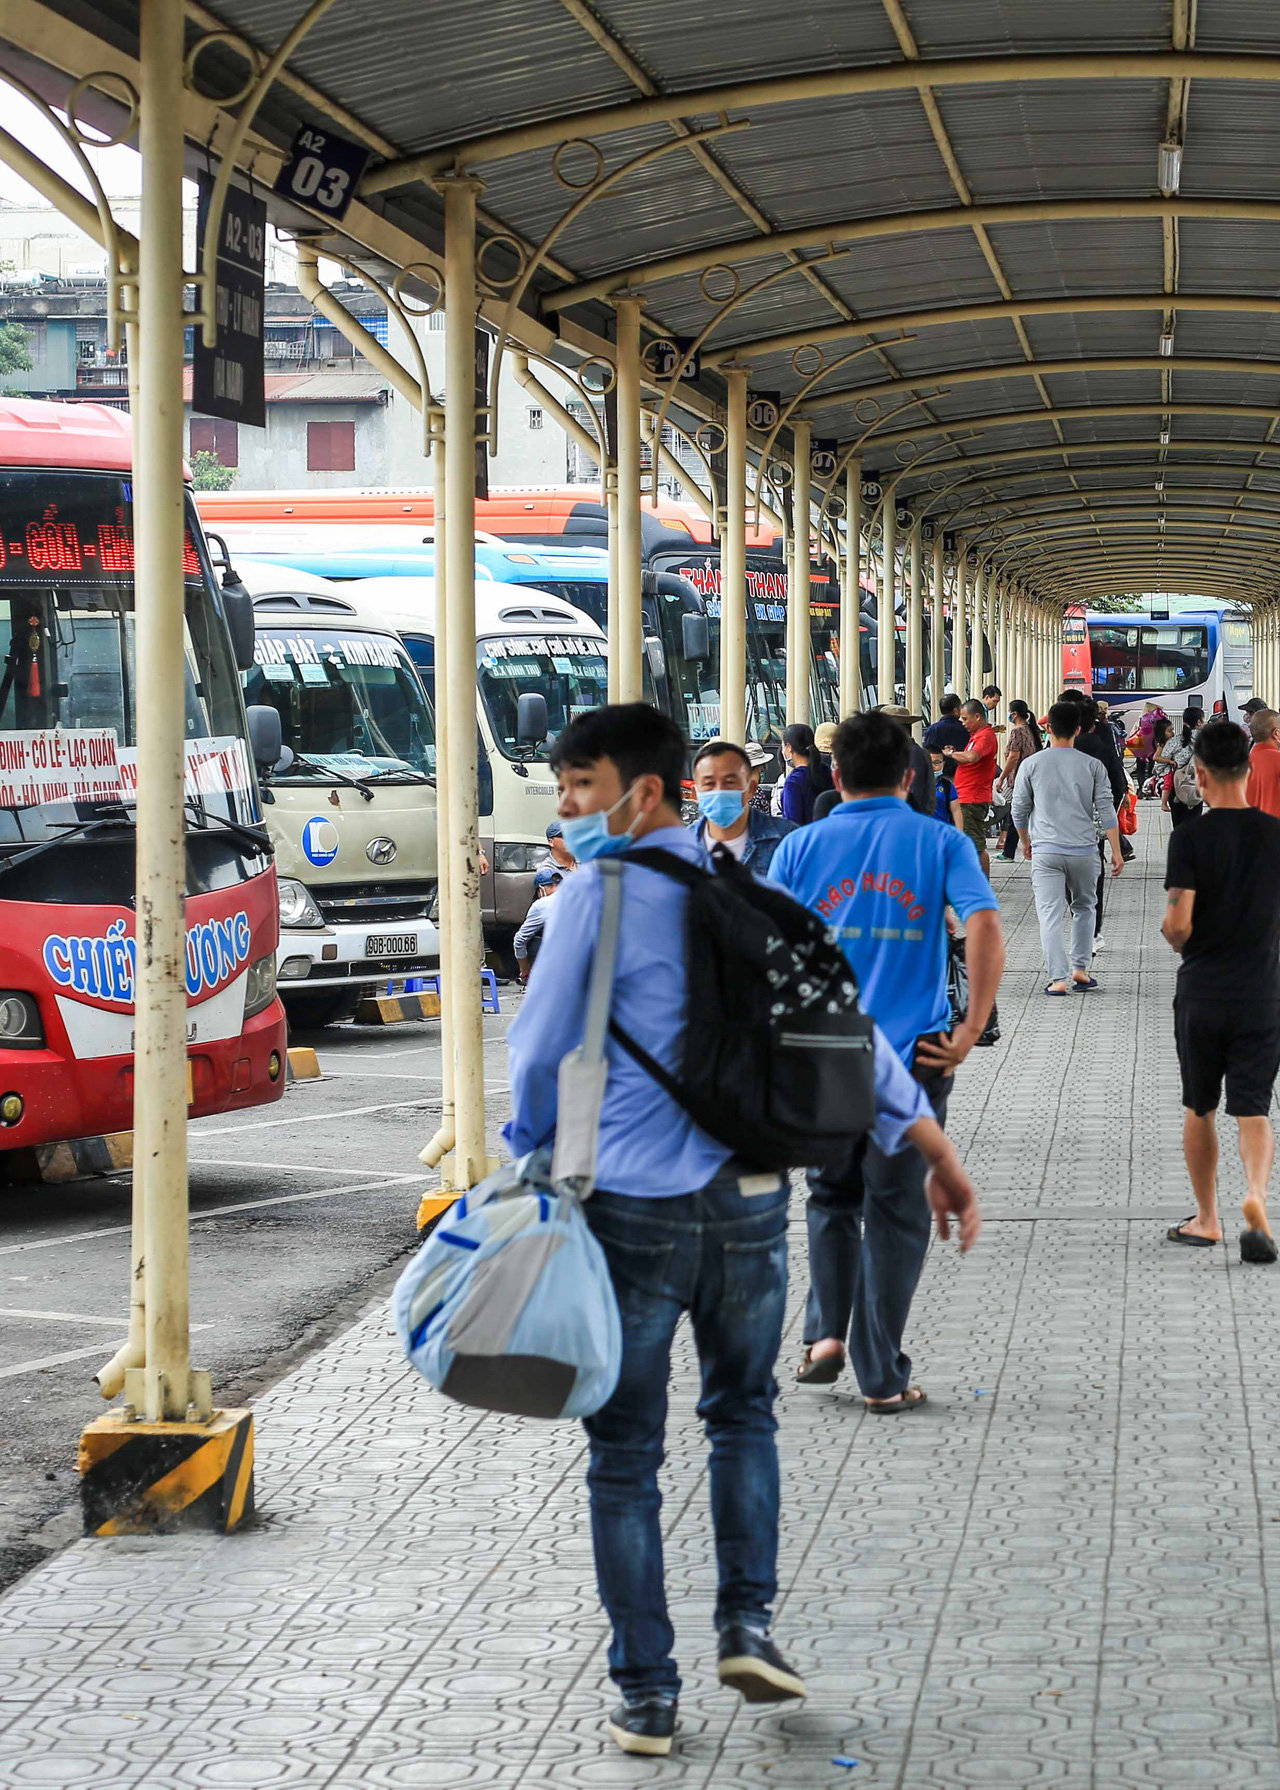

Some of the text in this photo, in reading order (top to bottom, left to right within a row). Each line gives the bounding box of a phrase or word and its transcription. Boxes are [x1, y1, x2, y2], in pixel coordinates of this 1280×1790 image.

[299, 131, 326, 153] A2
[291, 156, 350, 208] 03
[752, 405, 775, 425] 06
[745, 570, 788, 600] THAN
[701, 706, 720, 724] THA
[67, 738, 87, 771] LẠC
[43, 911, 251, 1005] CHIẾ ƯƠNG
[368, 936, 416, 955] 90B-000.66
